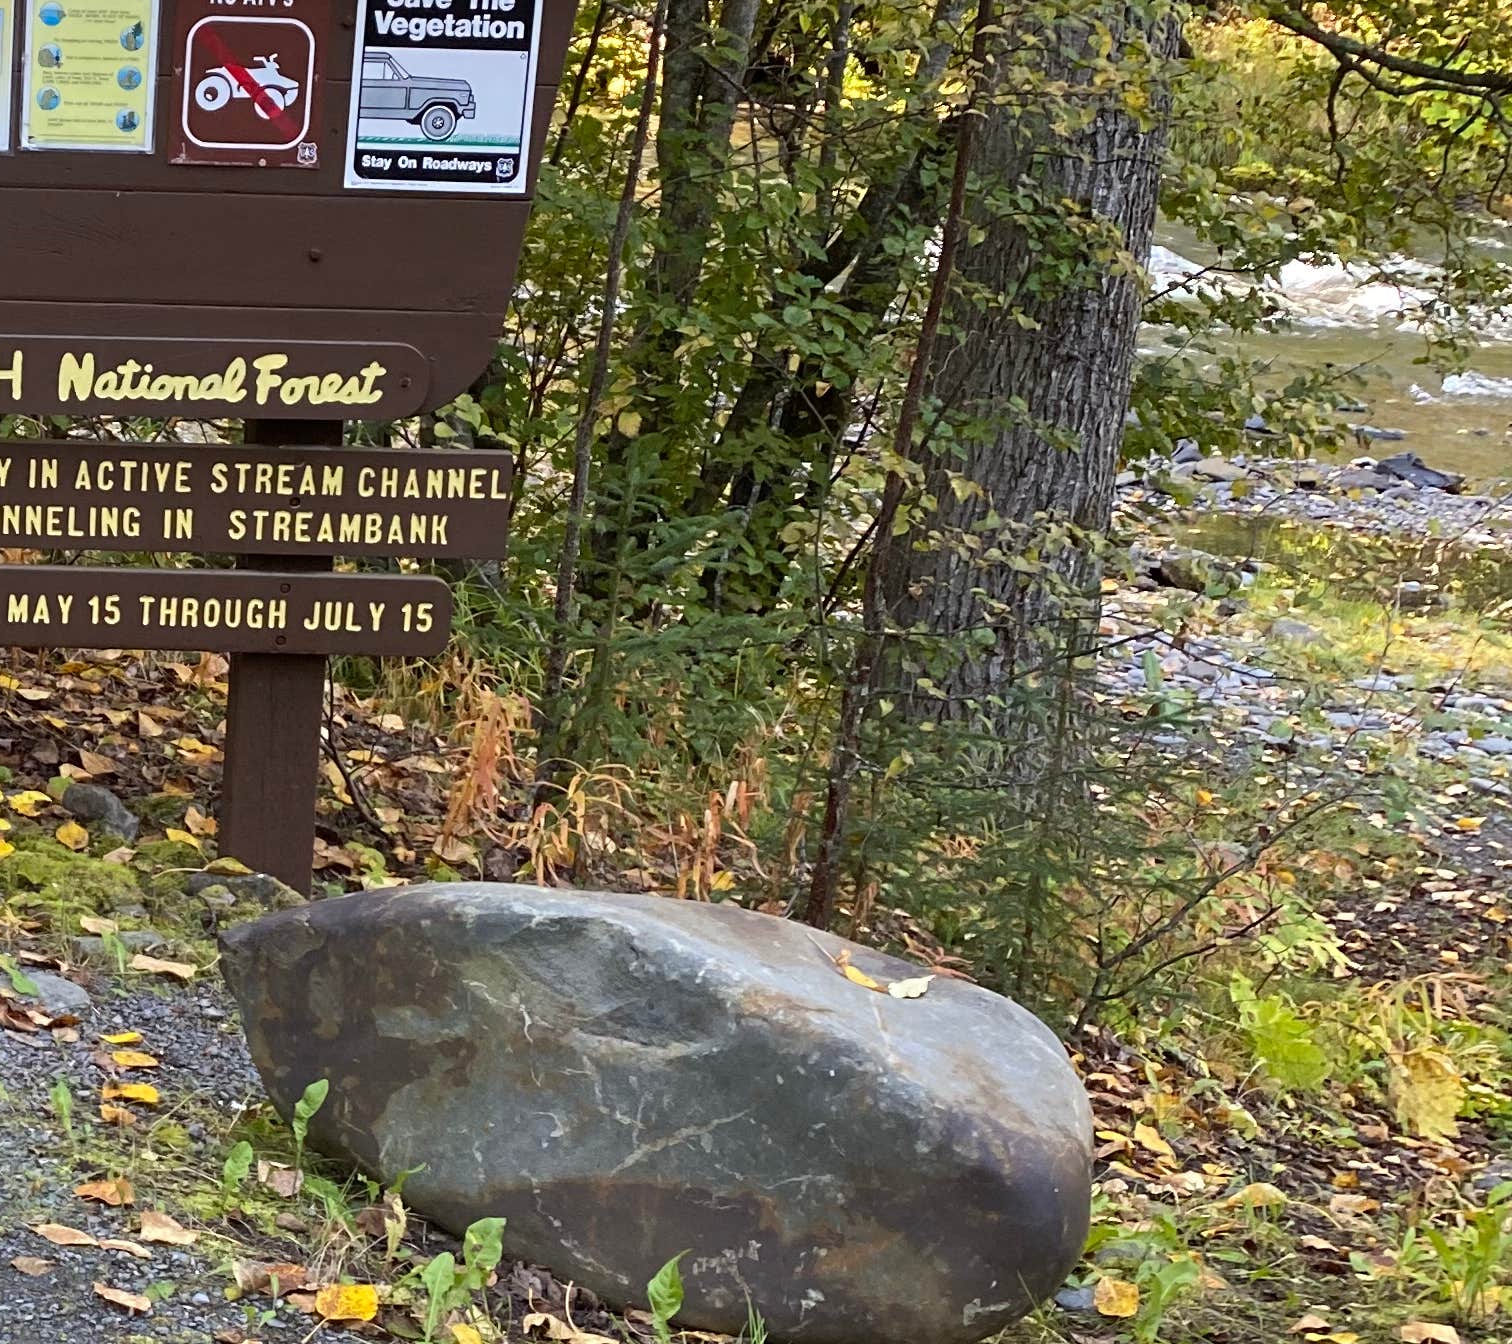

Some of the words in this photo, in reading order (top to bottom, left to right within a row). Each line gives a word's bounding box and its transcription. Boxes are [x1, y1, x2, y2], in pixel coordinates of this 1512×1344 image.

[374, 10, 525, 41] Vegetation
[361, 155, 392, 170] Stay
[398, 156, 417, 169] On
[422, 157, 492, 174] Roadways
[57, 352, 247, 404] National
[253, 353, 388, 406] Forest
[29, 458, 58, 489] IN
[75, 461, 193, 494] ACTIVE
[210, 463, 343, 496] STREAM
[164, 508, 194, 539] IN
[228, 509, 449, 546] STREAMBANK
[8, 593, 73, 625] MAY
[88, 595, 120, 625] 15
[139, 595, 287, 629] THROUGH
[303, 601, 385, 632] JULY
[402, 602, 433, 633] 15
